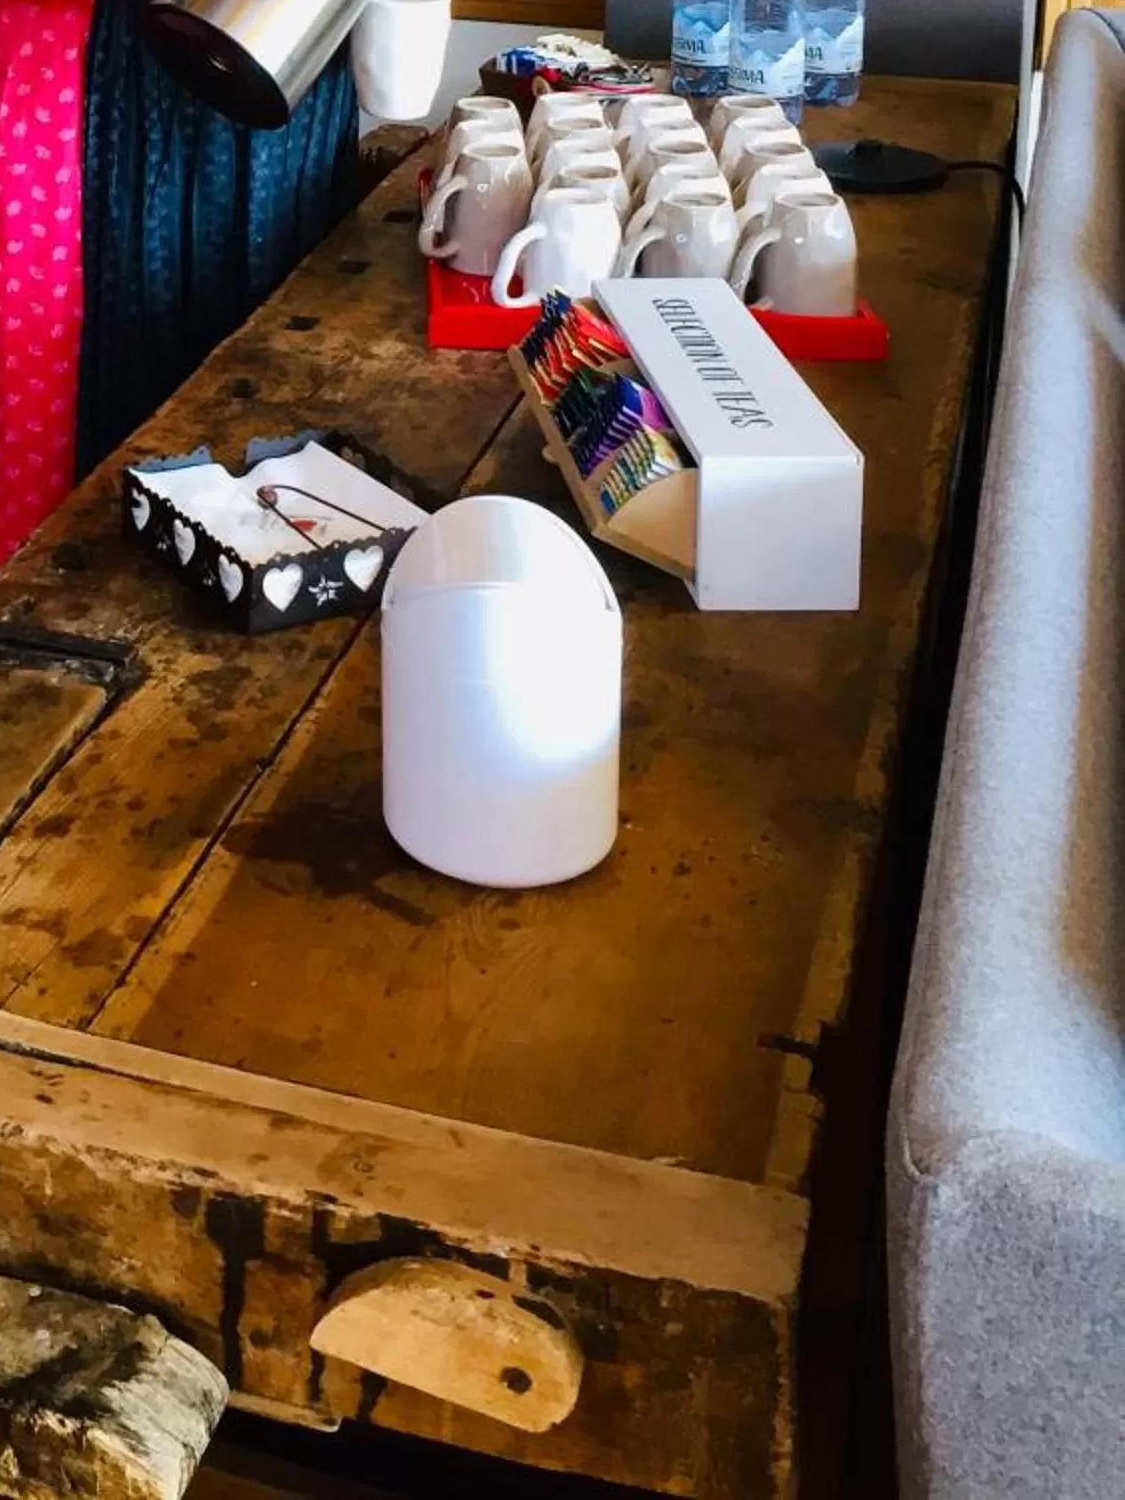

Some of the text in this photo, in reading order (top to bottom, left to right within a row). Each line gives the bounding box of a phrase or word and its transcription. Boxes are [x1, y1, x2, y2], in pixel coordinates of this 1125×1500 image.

[651, 298, 774, 428] SELECTION OF TEAS
